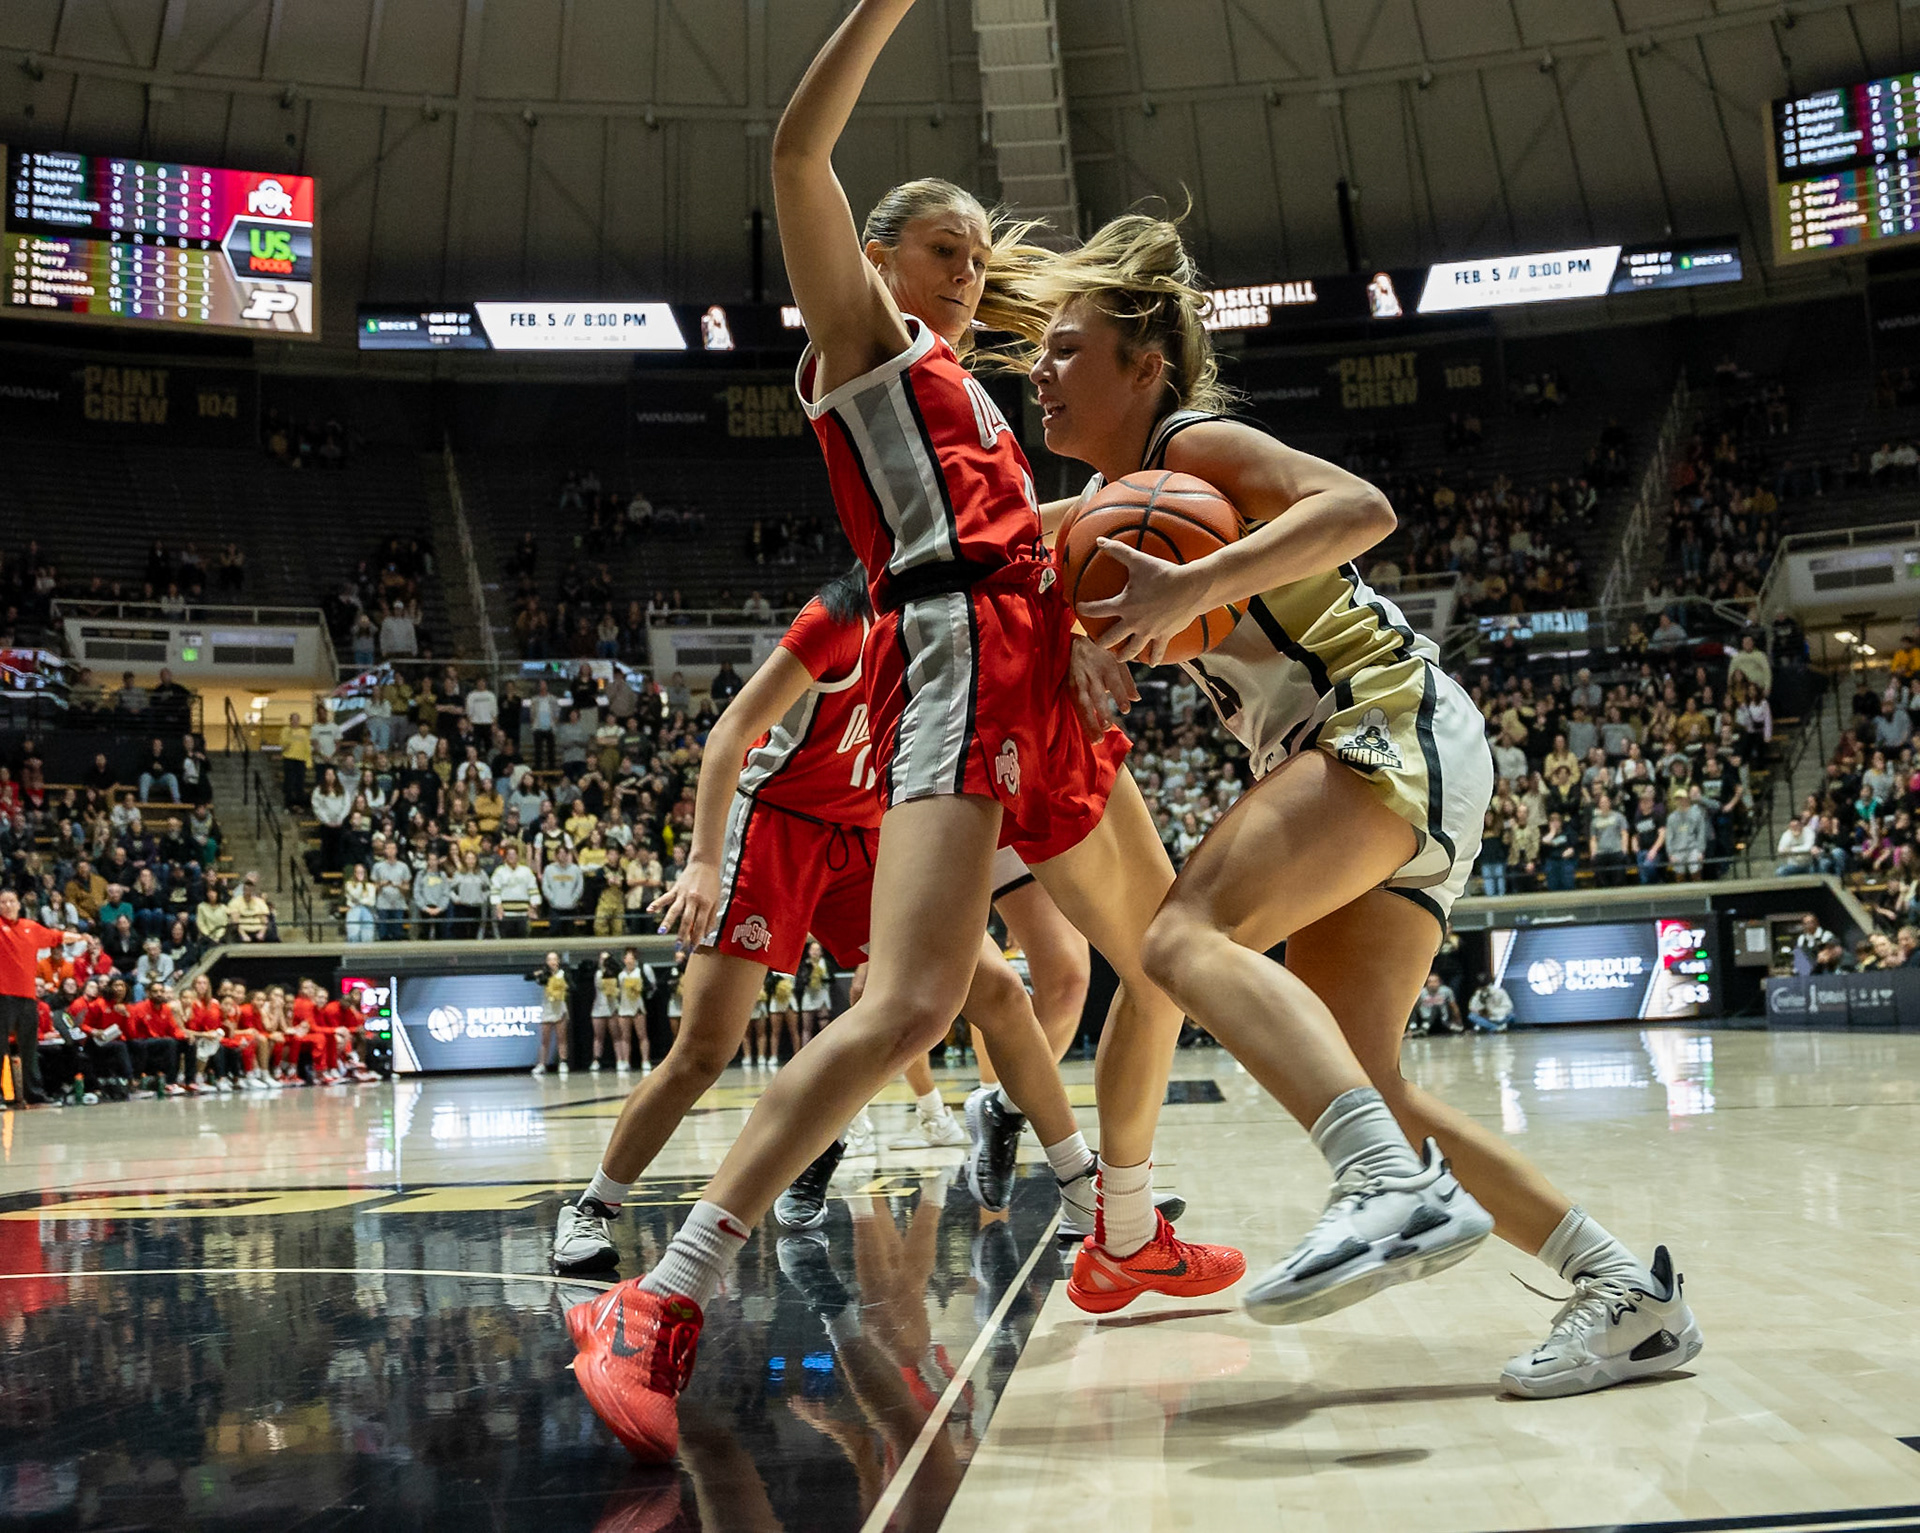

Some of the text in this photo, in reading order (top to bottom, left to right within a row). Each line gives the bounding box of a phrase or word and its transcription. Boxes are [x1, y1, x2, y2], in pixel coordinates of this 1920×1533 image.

[33, 153, 80, 171] Thierry
[110, 163, 125, 176] 12
[182, 170, 189, 182] 1
[202, 172, 212, 184] 2
[112, 176, 122, 188] 7
[137, 178, 144, 190] 1
[32, 180, 74, 196] Taylor
[157, 194, 166, 206] 4
[181, 196, 188, 208] 1
[201, 198, 211, 210] 4
[134, 218, 146, 230] 11
[136, 205, 144, 216] 1
[157, 207, 166, 219] 2
[201, 211, 211, 223] 4
[156, 236, 165, 247] A
[30, 239, 70, 254] Jones
[110, 247, 122, 258] 11
[134, 248, 143, 261] 2
[156, 250, 165, 262] 2
[203, 255, 210, 267] 1
[30, 252, 66, 268] Terry
[156, 264, 165, 276] 4
[203, 268, 210, 280] 1
[1568, 258, 1591, 272] PM
[135, 276, 142, 287] 1
[203, 282, 210, 293] 1
[108, 286, 122, 299] 12
[133, 288, 142, 300] 7
[157, 291, 165, 303] 1
[200, 295, 210, 306] 4
[109, 300, 122, 312] 11
[157, 304, 164, 316] 1
[584, 313, 617, 326] 8:00
[623, 314, 646, 326] PM
[1340, 352, 1418, 382] PAINT
[84, 365, 169, 396] PAINT
[1342, 378, 1418, 408] CREW
[84, 394, 169, 424] CREW
[728, 412, 804, 438] CREW
[1341, 748, 1400, 767] PURDUE
[1565, 957, 1643, 978] PURDUE
[466, 1006, 544, 1025] PURDUE
